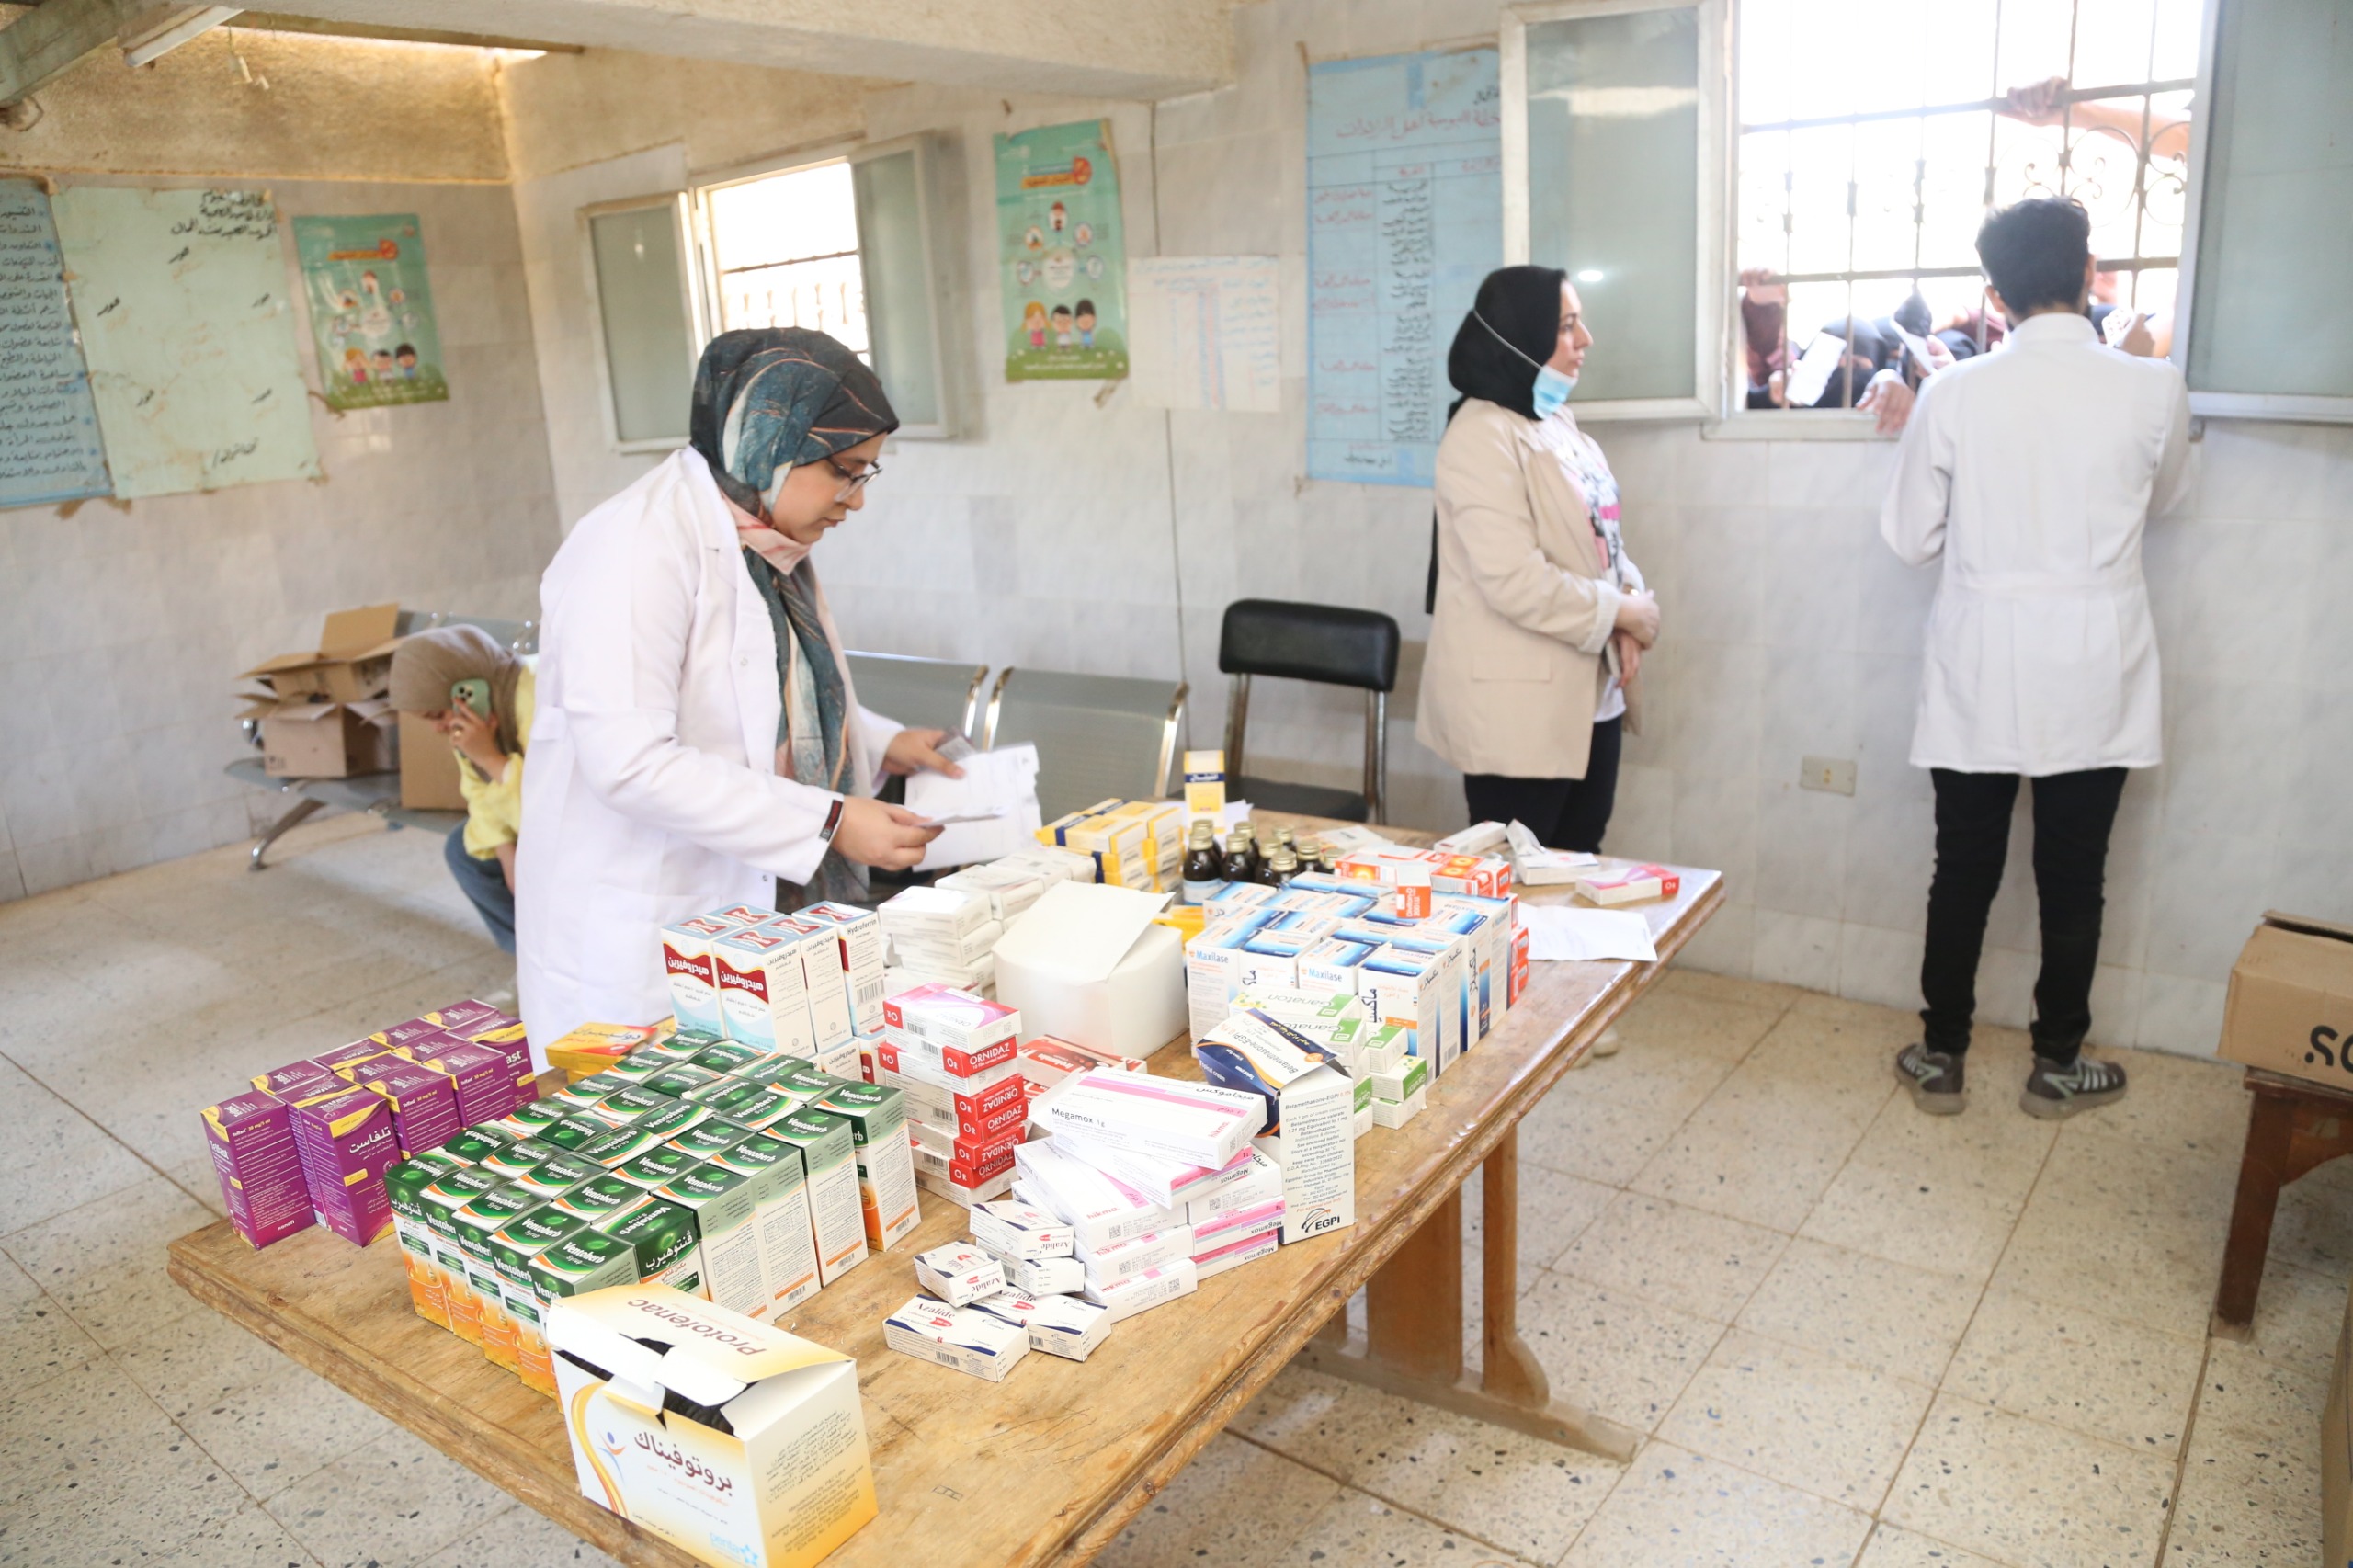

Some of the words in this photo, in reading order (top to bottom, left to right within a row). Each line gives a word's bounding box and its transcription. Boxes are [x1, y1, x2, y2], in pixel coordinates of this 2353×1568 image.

[847, 919, 877, 935] Hydroferrin
[1196, 950, 1229, 964] Maxilase
[668, 957, 709, 975] هيدروفيرين
[721, 971, 764, 991] هيدروفيرين
[1308, 968, 1343, 983] Maxilase
[1267, 994, 1332, 1007] Ganaton
[1284, 1022, 1342, 1032] Ganato
[969, 1042, 1010, 1066] ORNIDAZ
[1232, 1031, 1298, 1074] Betamethasone-EGPI
[754, 1059, 795, 1079] Ventoherb
[1199, 1059, 1213, 1074] Topical
[791, 1073, 829, 1086] Ventoherb
[705, 1081, 749, 1102] Ventoherb
[839, 1089, 882, 1102] Ventoherb
[1195, 1085, 1255, 1101] ميجاموكس
[733, 1096, 778, 1119] Ventoherb
[983, 1088, 1018, 1113] ORNIDAZ
[1285, 1093, 1339, 1110] Betamethasone-EGPI
[643, 1104, 691, 1128] Ventoherb
[987, 1105, 1023, 1130] ORNIDAZ
[1051, 1107, 1094, 1124] Megamox
[1290, 1116, 1326, 1128] Betamethasone
[1327, 1111, 1344, 1120] valerate
[787, 1118, 828, 1133] Ventoherb
[1306, 1120, 1331, 1130] Equivalent
[349, 1126, 392, 1153] تلفاست
[588, 1130, 638, 1154] Ventoherb
[691, 1129, 730, 1145] Ventoherb
[1305, 1138, 1325, 1146] enclosed
[511, 1144, 548, 1160] Ventoherb
[735, 1144, 776, 1162] Ventoherb
[982, 1138, 1019, 1162] ORNIDAZ
[1302, 1150, 1324, 1158] exceeding
[1313, 1141, 1338, 1151] temperature
[545, 1162, 584, 1178] Ventoherb
[638, 1156, 677, 1174] Ventoherb
[978, 1153, 1013, 1176] ORNIDAZ
[1323, 1162, 1352, 1173] Pharmaceutical
[453, 1172, 491, 1189] Ventoherb
[684, 1175, 724, 1192] Ventoherb
[1220, 1167, 1249, 1185] Megamox
[485, 1192, 524, 1210] Ventoherb
[581, 1187, 620, 1205] Ventoherb
[278, 1219, 295, 1231] sanofi
[522, 1217, 562, 1237] Ventoherb
[619, 1206, 672, 1235] Ventoherb
[1251, 1220, 1283, 1234] Megamox
[1315, 1215, 1340, 1231] EGPI
[563, 1242, 606, 1264] Ventoherb
[1040, 1242, 1071, 1251] Azalide
[1244, 1246, 1275, 1261] Megamox
[494, 1256, 533, 1281] Ventoherb
[972, 1277, 1002, 1292] Azalide
[915, 1302, 956, 1319] Azalide
[627, 1298, 767, 1357] Protofenac
[634, 1431, 733, 1497] بروتوفيناك
